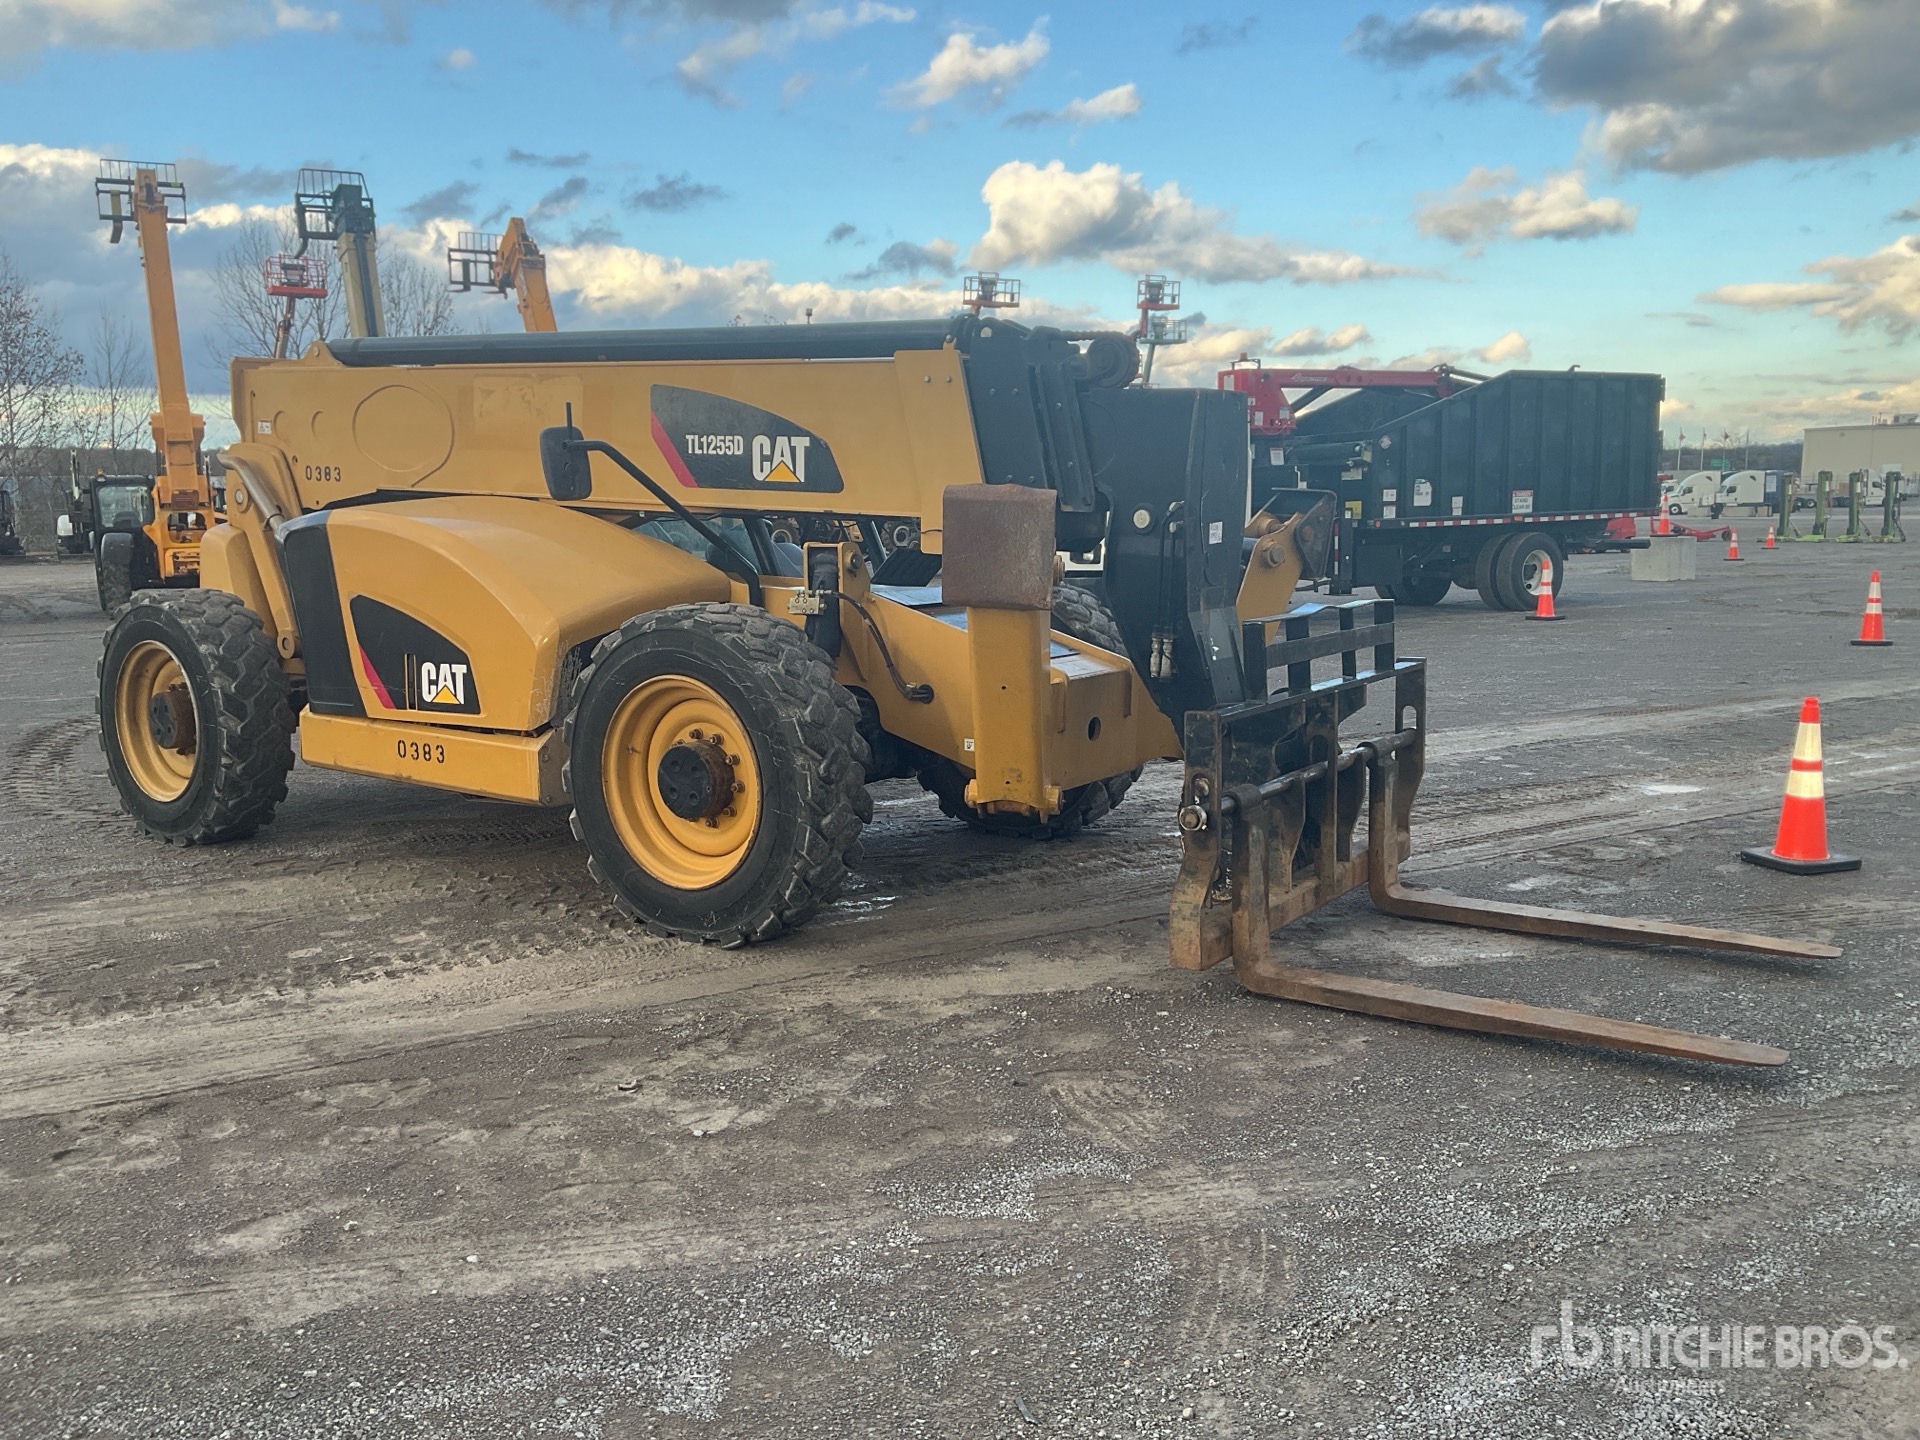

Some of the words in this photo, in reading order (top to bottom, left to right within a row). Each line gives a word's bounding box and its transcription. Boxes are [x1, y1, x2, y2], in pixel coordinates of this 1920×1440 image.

[305, 465, 341, 482] 0383
[685, 434, 744, 455] TL1255D
[752, 434, 810, 482] CAT
[421, 662, 467, 704] CAT
[397, 739, 445, 763] 0383
